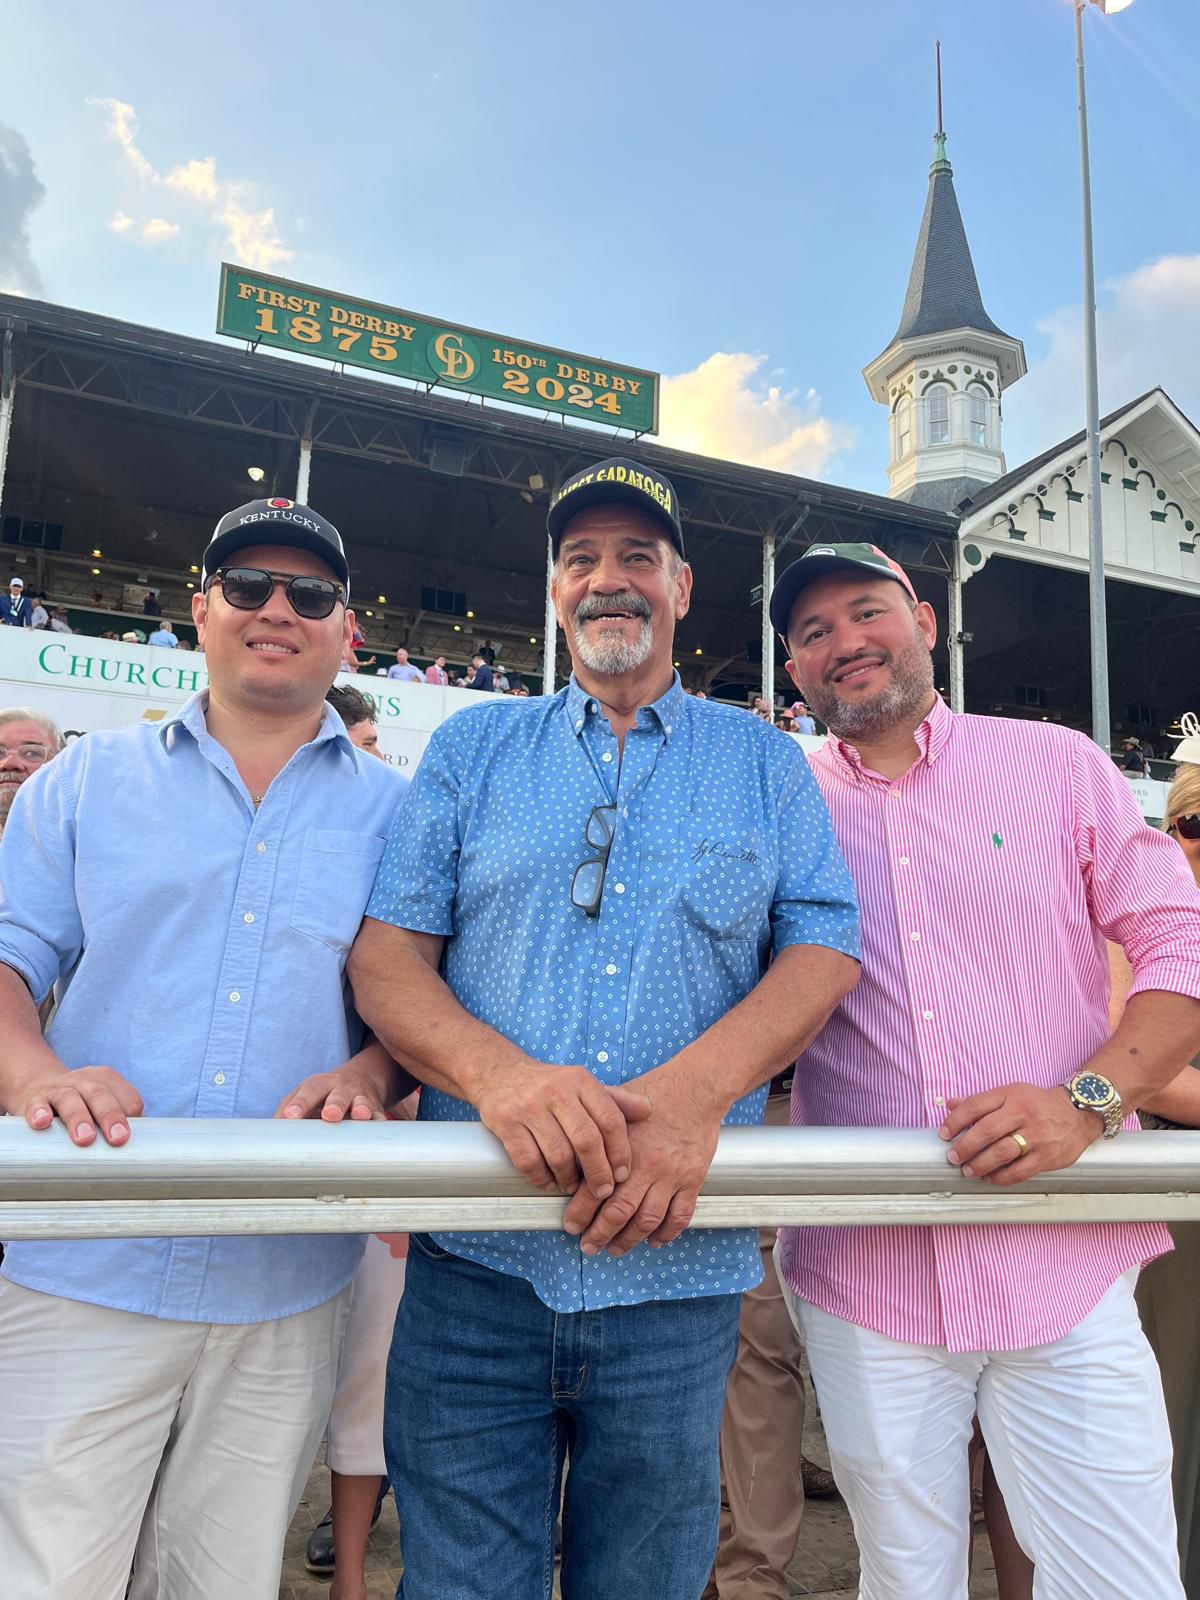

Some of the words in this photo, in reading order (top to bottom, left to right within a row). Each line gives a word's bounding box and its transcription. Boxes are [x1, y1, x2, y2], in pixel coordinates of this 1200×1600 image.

[237, 283, 320, 317] FIRST
[329, 306, 416, 341] DERBY
[255, 308, 398, 361] 1875
[502, 369, 621, 416] 2024
[556, 363, 641, 396] DERBY
[240, 510, 321, 532] KENTUCKY
